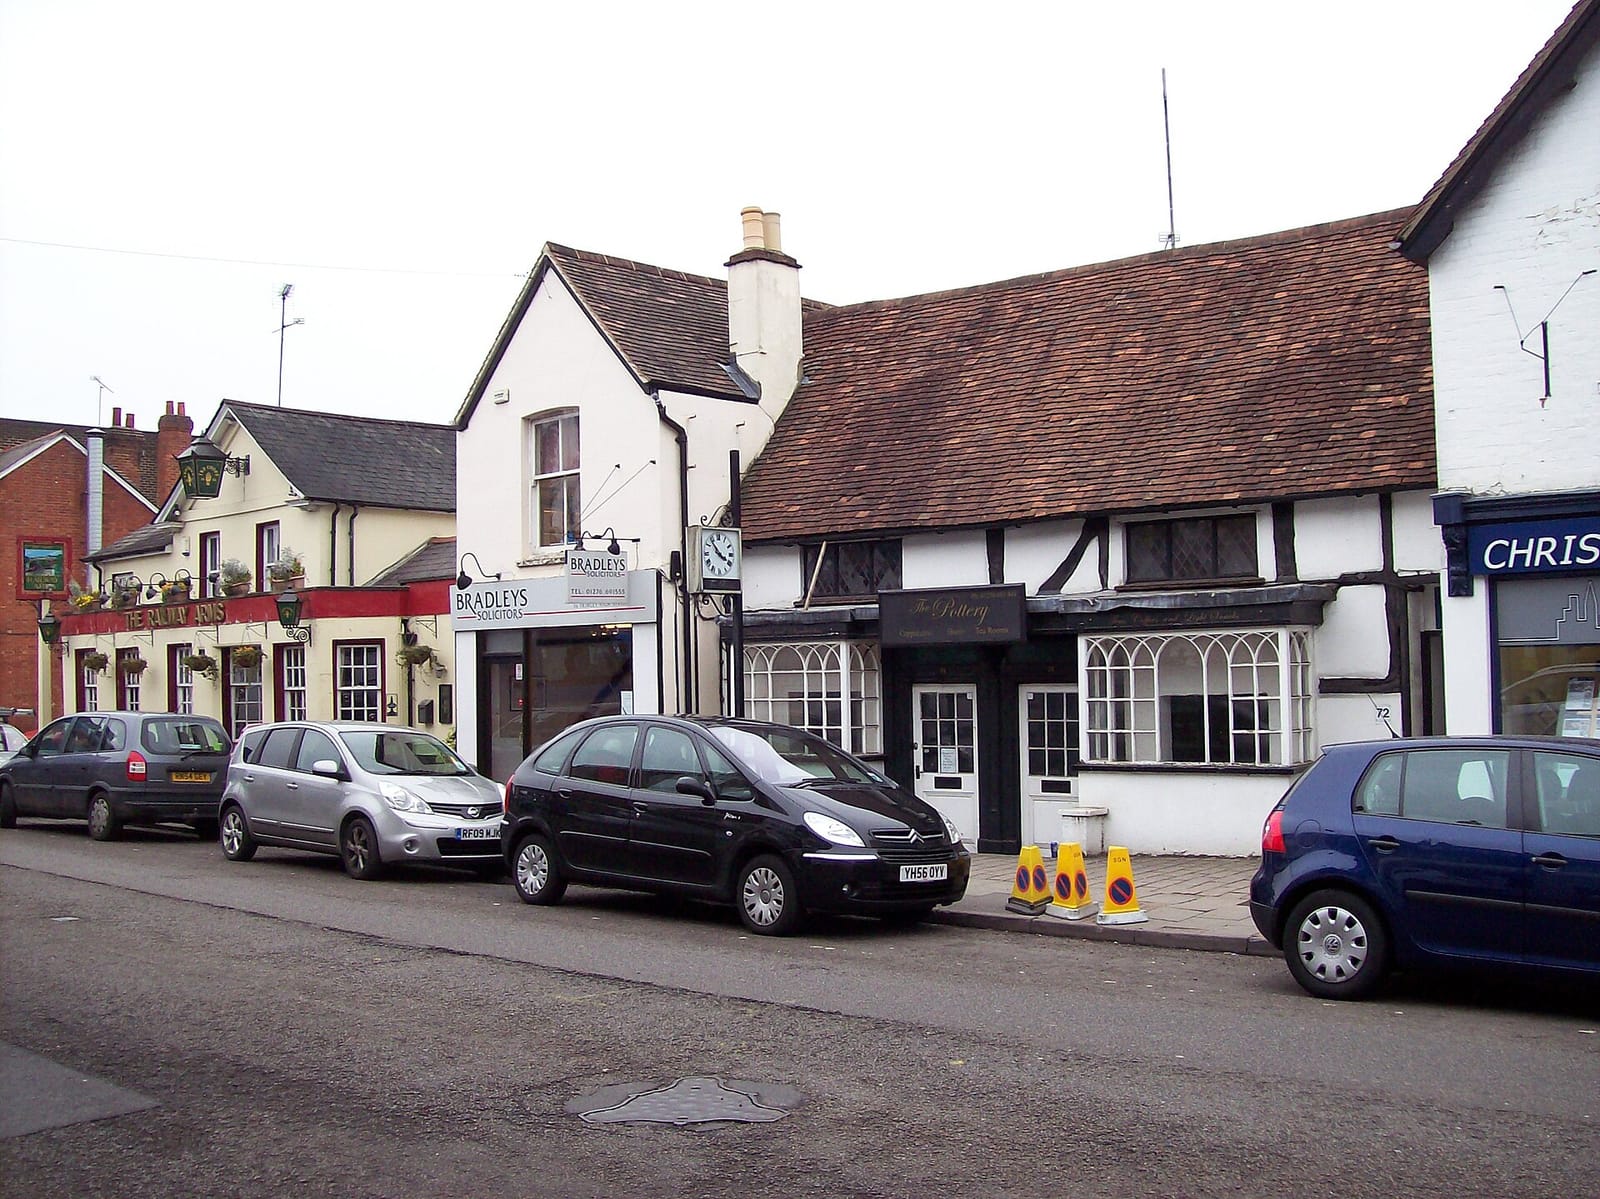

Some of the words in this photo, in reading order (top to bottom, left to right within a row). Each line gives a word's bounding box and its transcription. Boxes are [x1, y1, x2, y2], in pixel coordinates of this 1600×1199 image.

[1483, 533, 1600, 570] CHRIS
[571, 557, 626, 573] BRADLEYS
[456, 588, 528, 615] BRADLEYS
[124, 611, 145, 629] THE
[147, 606, 188, 627] RAILWAY
[195, 602, 226, 623] ARMS
[477, 608, 524, 621] SOLICITORS
[911, 598, 930, 614] The
[932, 597, 990, 626] Pottery
[1376, 707, 1390, 718] 72
[463, 828, 484, 839] RF09
[904, 866, 928, 879] YH56
